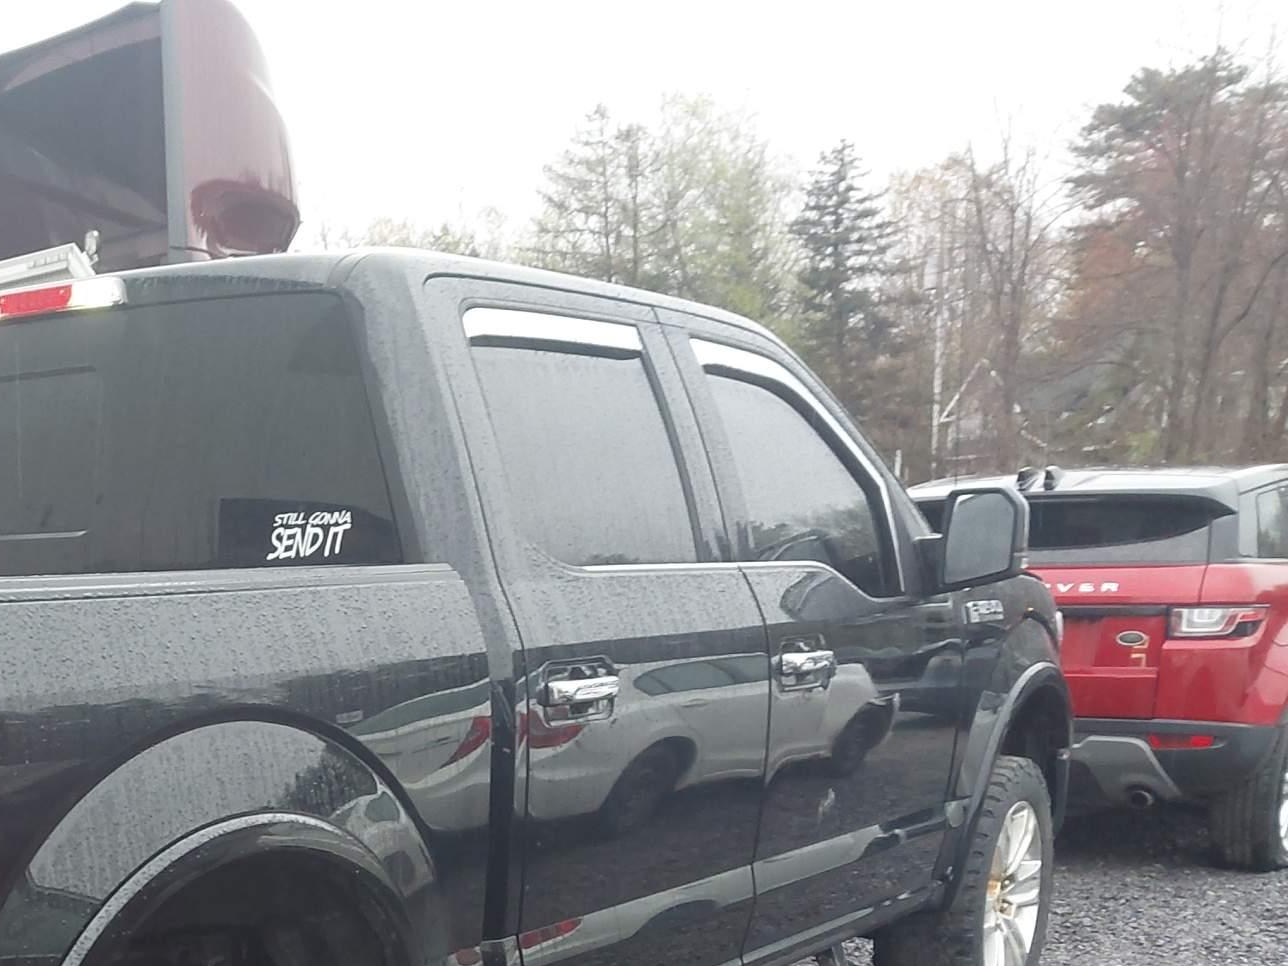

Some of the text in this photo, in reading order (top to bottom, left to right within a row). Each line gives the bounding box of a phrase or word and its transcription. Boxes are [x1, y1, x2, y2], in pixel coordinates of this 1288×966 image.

[272, 510, 352, 527] STILL GONNA
[266, 523, 352, 560] SEND IT
